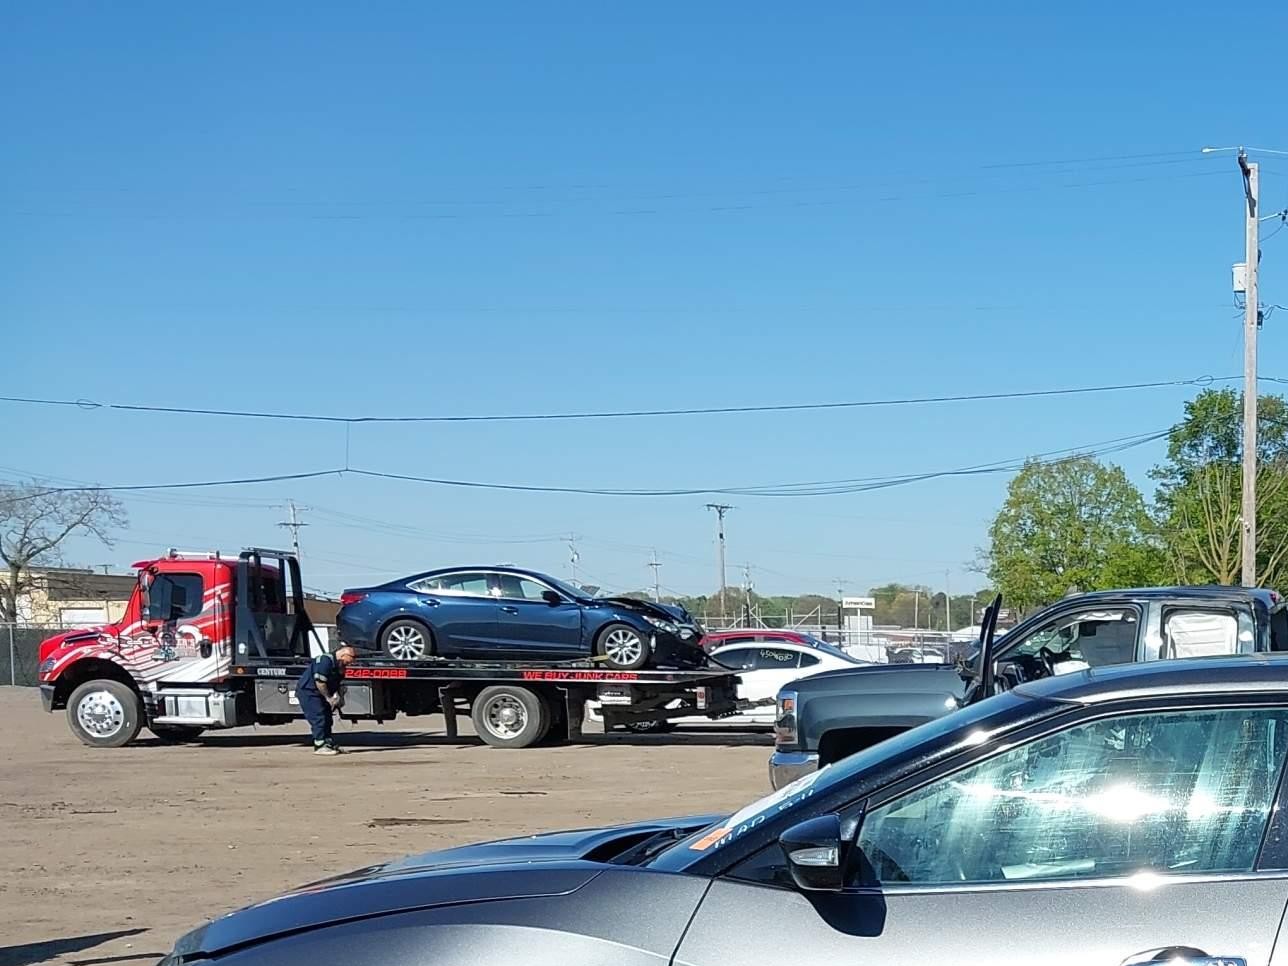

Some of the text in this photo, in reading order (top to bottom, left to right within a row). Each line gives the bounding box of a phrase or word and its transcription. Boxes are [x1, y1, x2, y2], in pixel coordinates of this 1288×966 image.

[257, 667, 287, 676] CENTURY
[523, 671, 638, 681] WE BUY JUNK CARS
